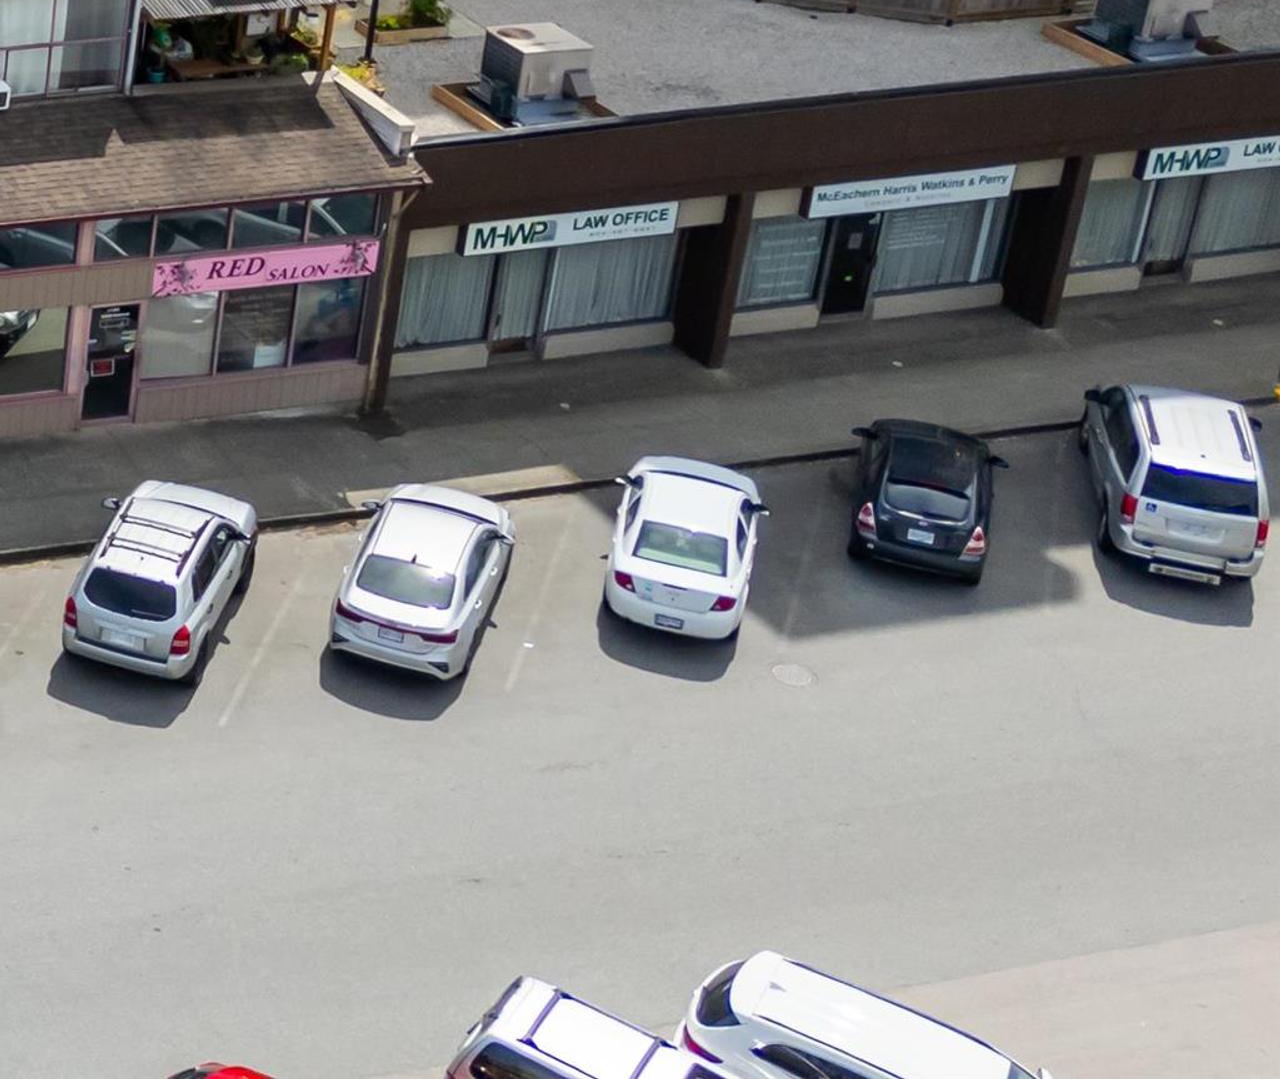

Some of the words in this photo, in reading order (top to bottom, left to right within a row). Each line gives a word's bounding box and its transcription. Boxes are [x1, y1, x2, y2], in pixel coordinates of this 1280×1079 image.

[1243, 141, 1276, 157] LAW
[883, 185, 917, 196] Harris
[921, 179, 965, 191] Watkins
[978, 174, 1009, 186] Perry
[573, 214, 609, 231] LAW
[612, 208, 670, 226] OFFICE
[206, 257, 265, 280] RED
[266, 263, 330, 282] SALON
